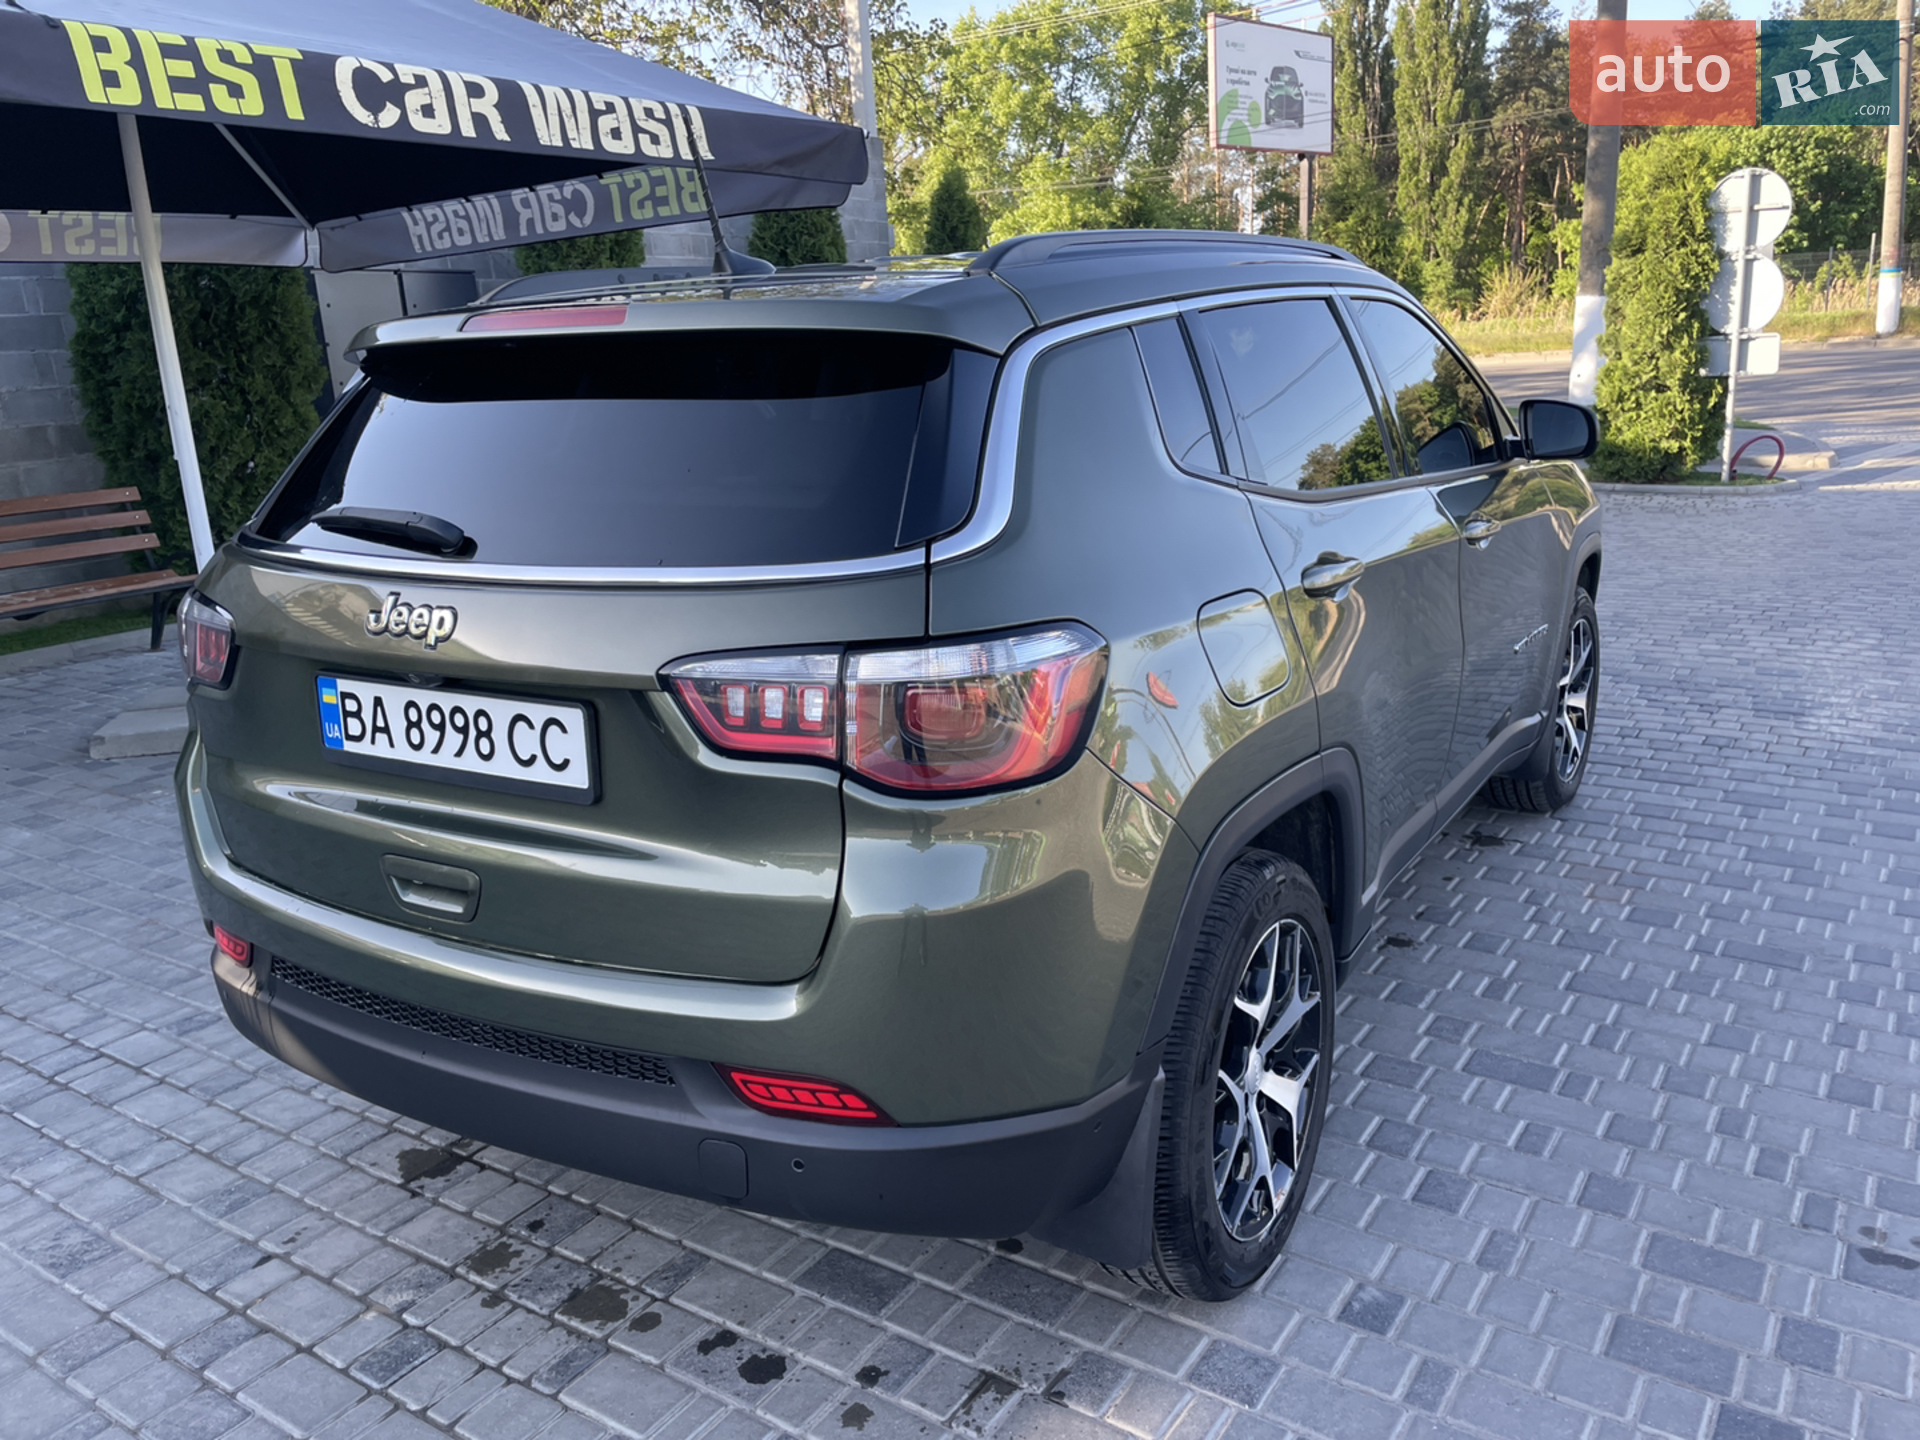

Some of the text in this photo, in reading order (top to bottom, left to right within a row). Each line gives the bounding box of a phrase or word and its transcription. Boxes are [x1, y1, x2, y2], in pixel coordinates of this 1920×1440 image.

[61, 19, 305, 120] BEST
[365, 591, 459, 650] Jeep
[325, 722, 341, 739] UA
[340, 691, 571, 772] BA 8998 CC
